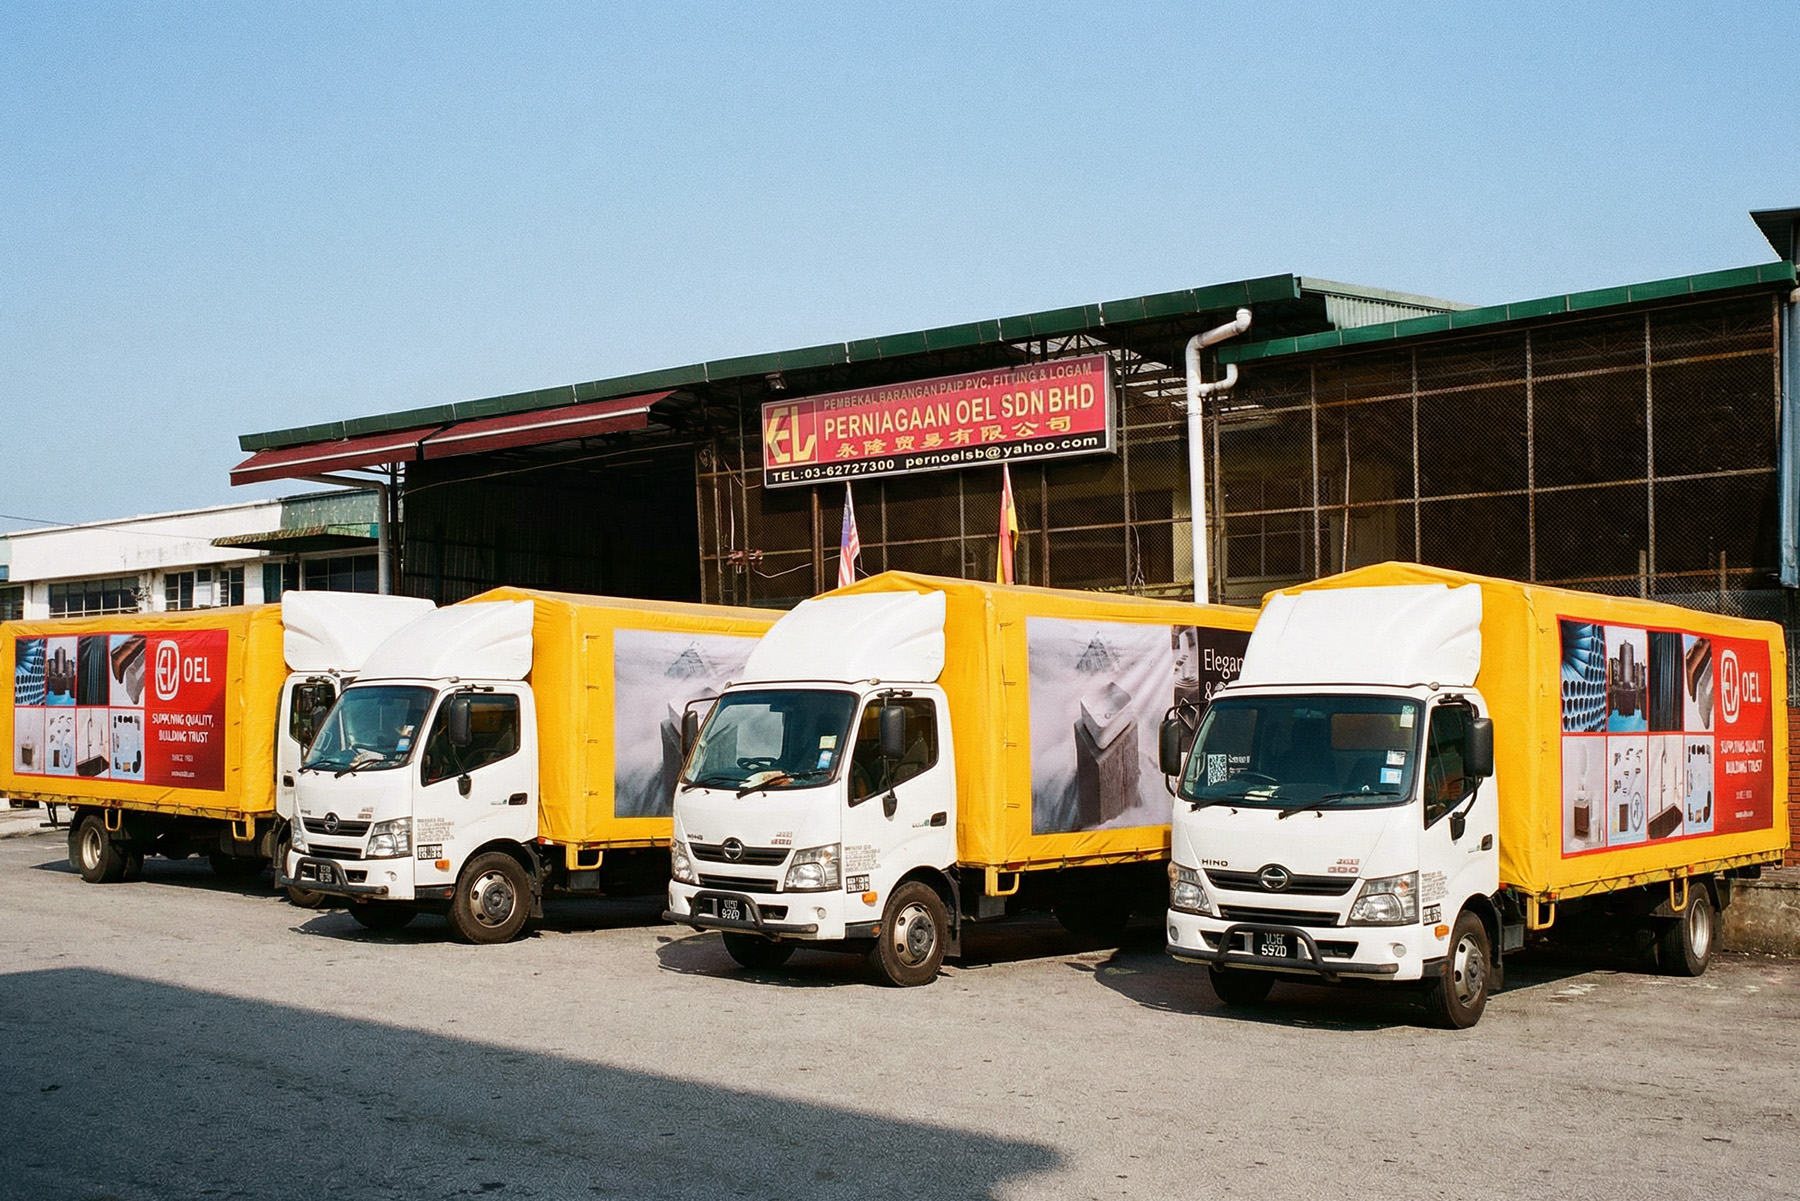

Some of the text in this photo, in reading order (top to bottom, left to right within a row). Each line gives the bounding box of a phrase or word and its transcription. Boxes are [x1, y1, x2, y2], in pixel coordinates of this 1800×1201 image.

[824, 362, 1093, 410] PEMBEKAL BARANGAN PAIP PVC, FITTING & LOGAM
[824, 383, 1095, 441] PERNIAGAAN OEL SDN BHD
[835, 415, 1072, 458] 永隆贸易有限公司
[772, 437, 1098, 482] TEL:03-62727300 pernoelsb@yahoo.com
[184, 657, 212, 683] OEL
[1742, 672, 1762, 703] OEL
[188, 731, 209, 743] TRUST
[1201, 858, 1229, 867] HINO
